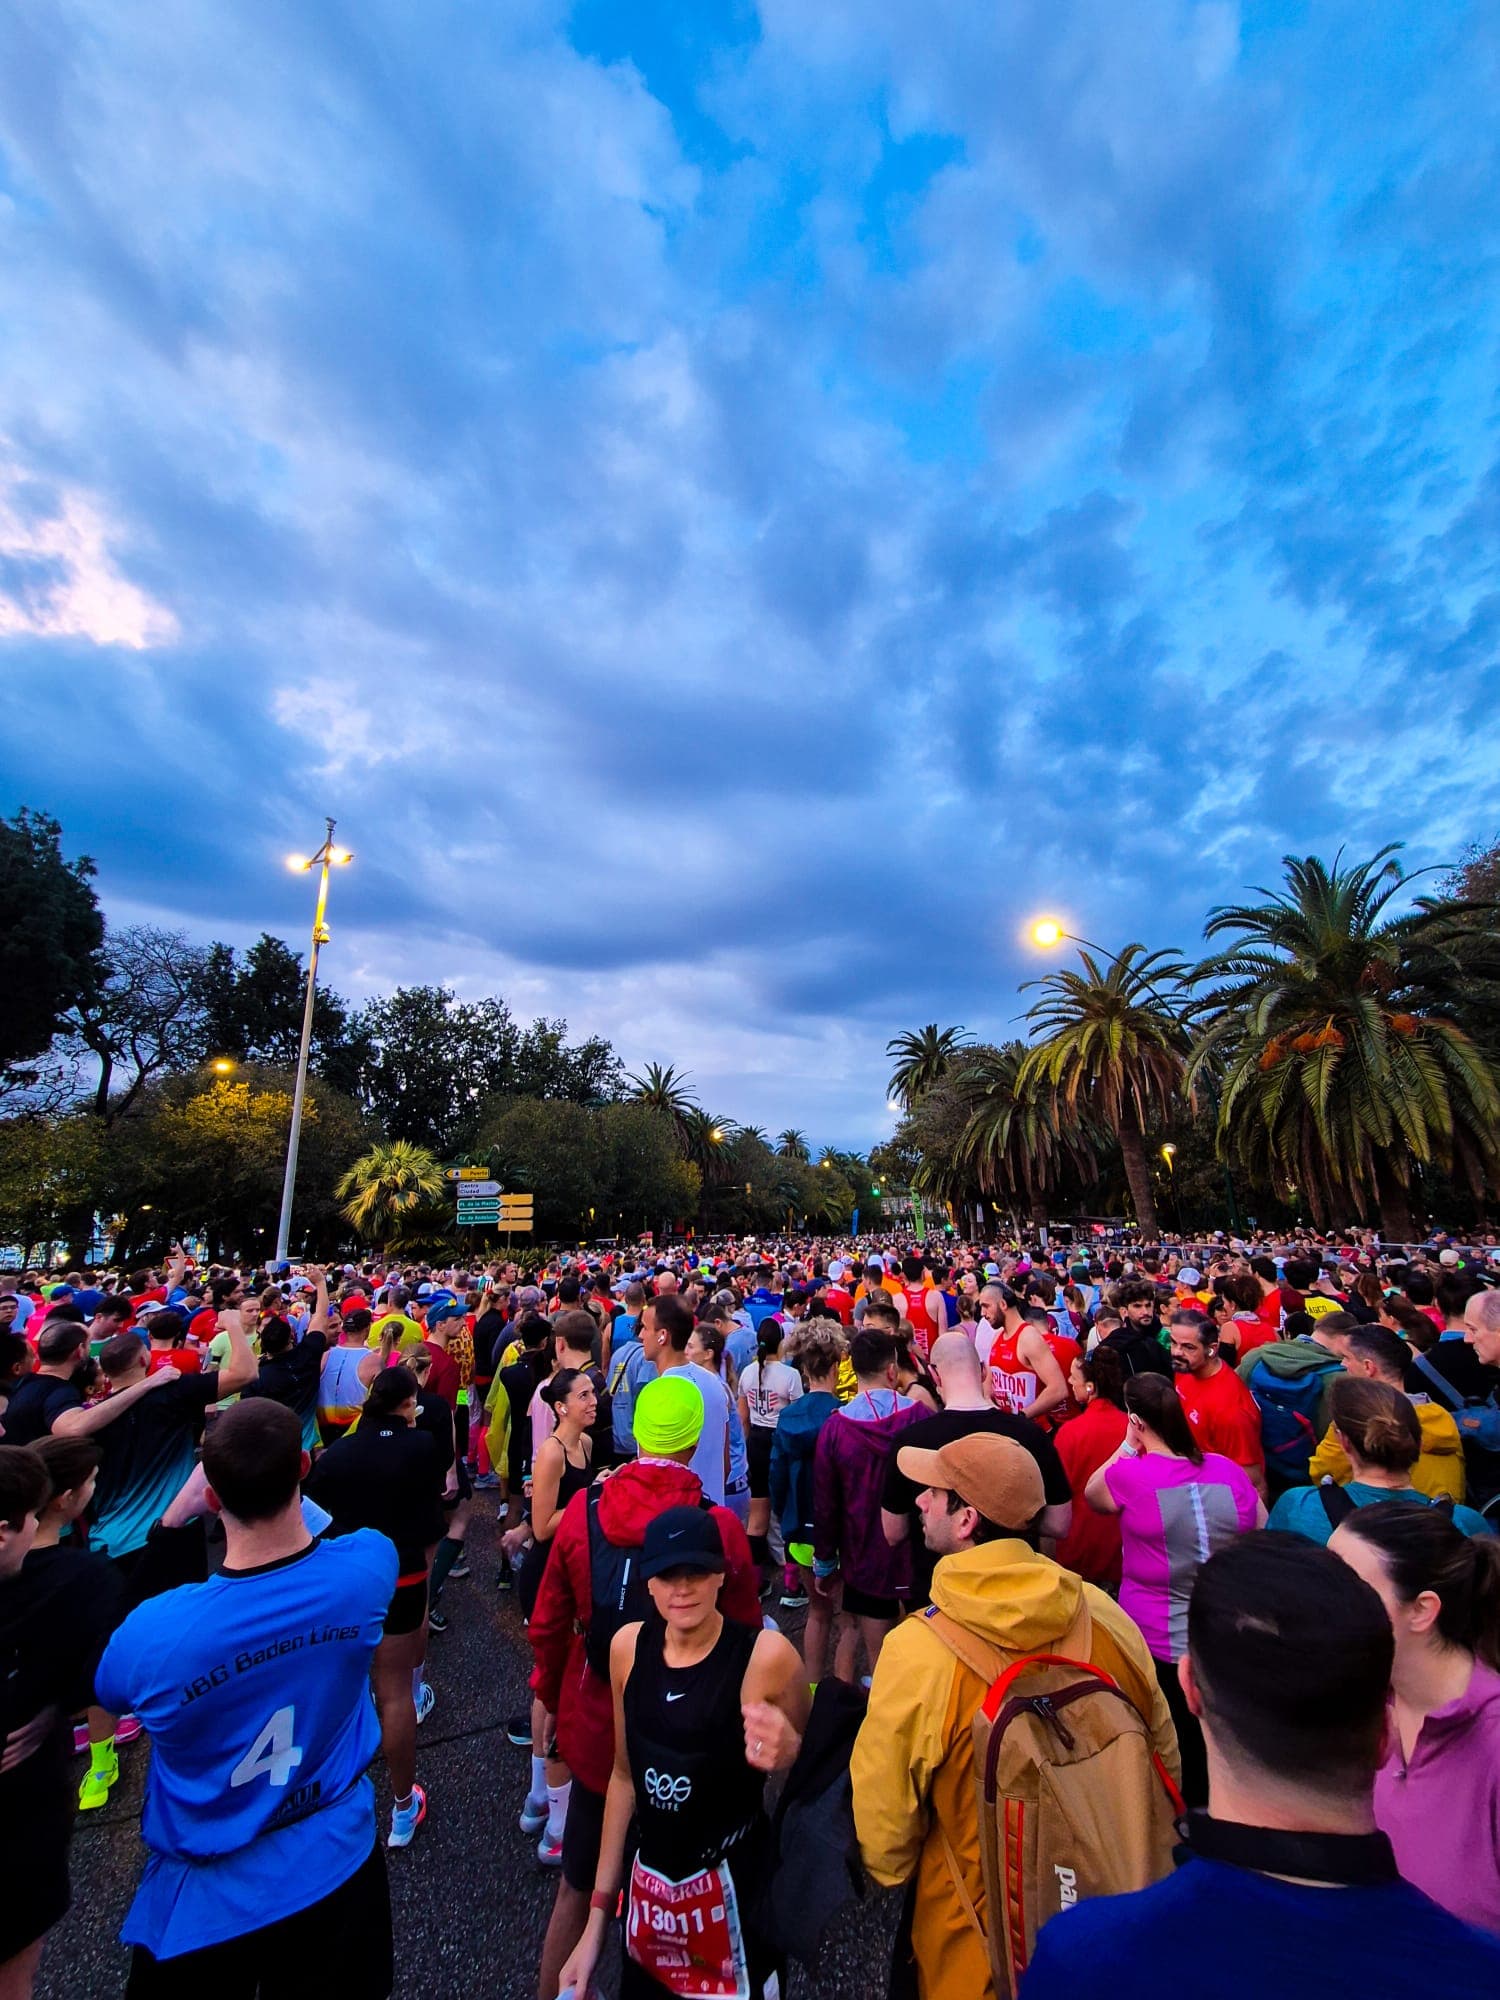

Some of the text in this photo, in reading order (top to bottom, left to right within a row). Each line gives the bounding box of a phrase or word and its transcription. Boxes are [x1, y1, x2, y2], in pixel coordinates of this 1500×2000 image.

[235, 1636, 304, 1674] Baden
[310, 1624, 361, 1647] Lines
[230, 1704, 303, 1788] 4
[640, 1900, 704, 1935] 13011
